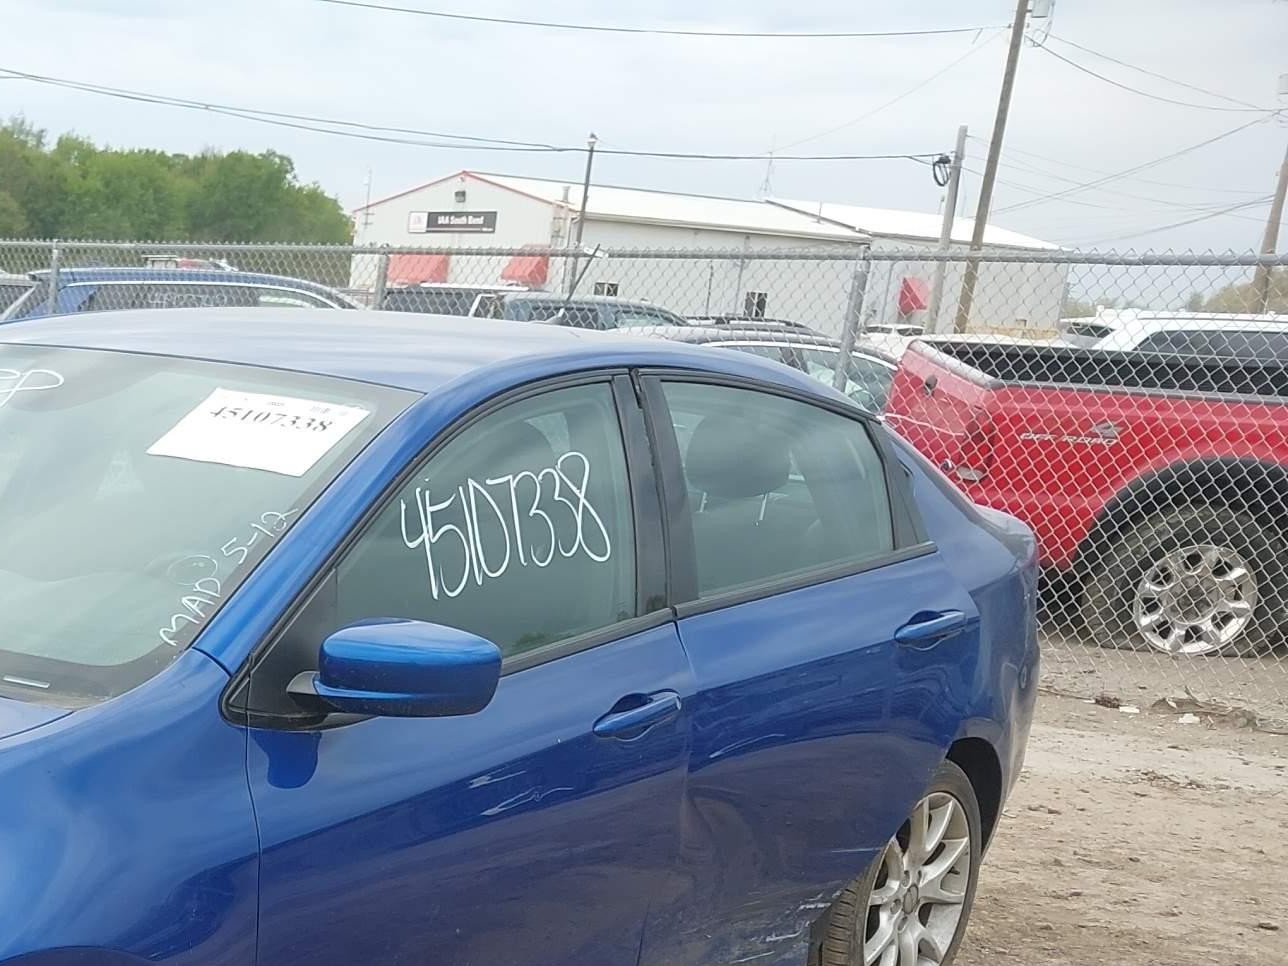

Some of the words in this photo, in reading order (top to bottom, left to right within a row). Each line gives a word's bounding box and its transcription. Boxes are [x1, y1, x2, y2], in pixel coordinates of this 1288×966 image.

[210, 406, 334, 432] 45107338
[400, 451, 611, 600] 45107338
[159, 577, 221, 646] MAD
